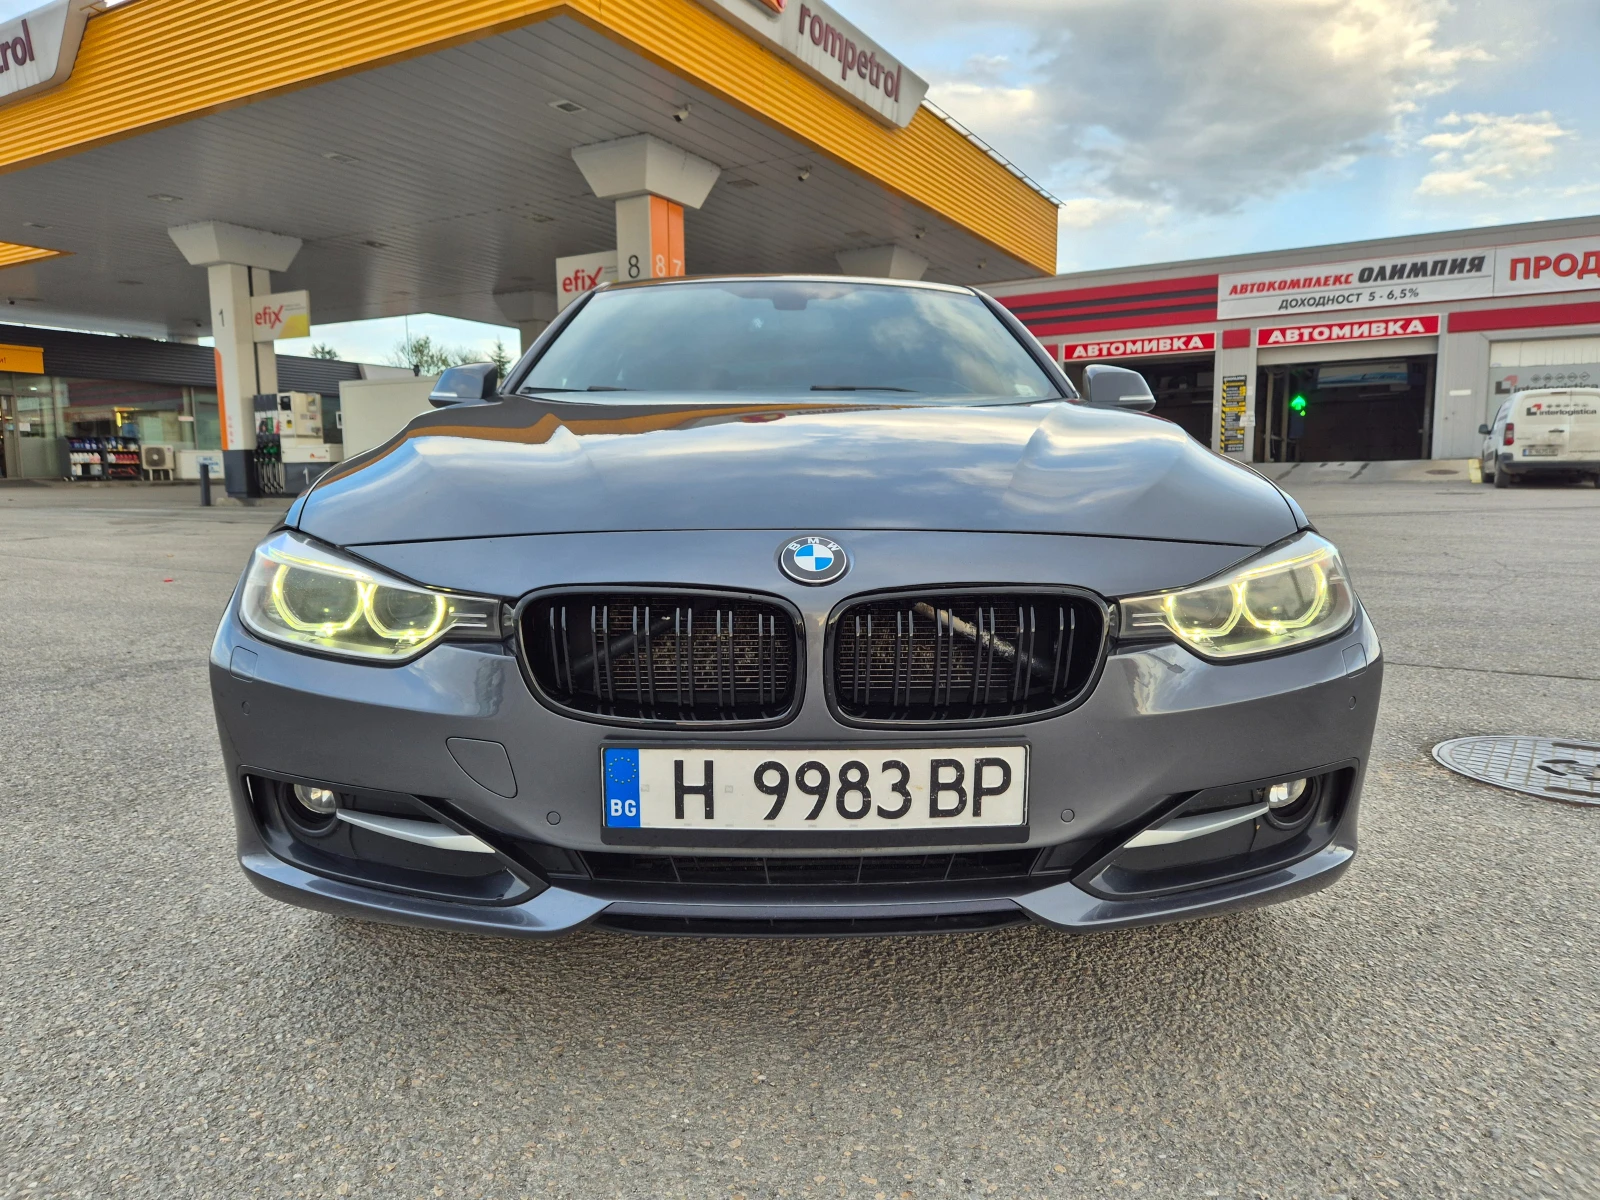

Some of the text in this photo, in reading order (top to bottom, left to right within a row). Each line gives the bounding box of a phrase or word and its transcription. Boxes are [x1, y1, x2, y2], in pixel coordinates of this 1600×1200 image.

[0, 18, 35, 74] rol
[798, 3, 902, 102] rompetrol
[628, 254, 640, 279] 8
[1229, 255, 1486, 296] АВТОКОМПЛЕКС ОЛИМПИЯ
[1509, 250, 1600, 281] ПРОД
[562, 266, 603, 293] efix
[1278, 292, 1363, 311] ДОХОДНОСТ
[1368, 291, 1376, 302] 5
[1386, 288, 1420, 301] 6,5%
[218, 308, 225, 327] 1
[254, 305, 284, 329] efix
[1267, 318, 1425, 344] АВТОМИВКА
[1072, 335, 1204, 358] АВТОМИВКА
[1539, 408, 1597, 416] interlogistica
[787, 537, 840, 551] BMW
[673, 757, 1012, 821] H 9983 BP
[611, 799, 637, 817] BG
